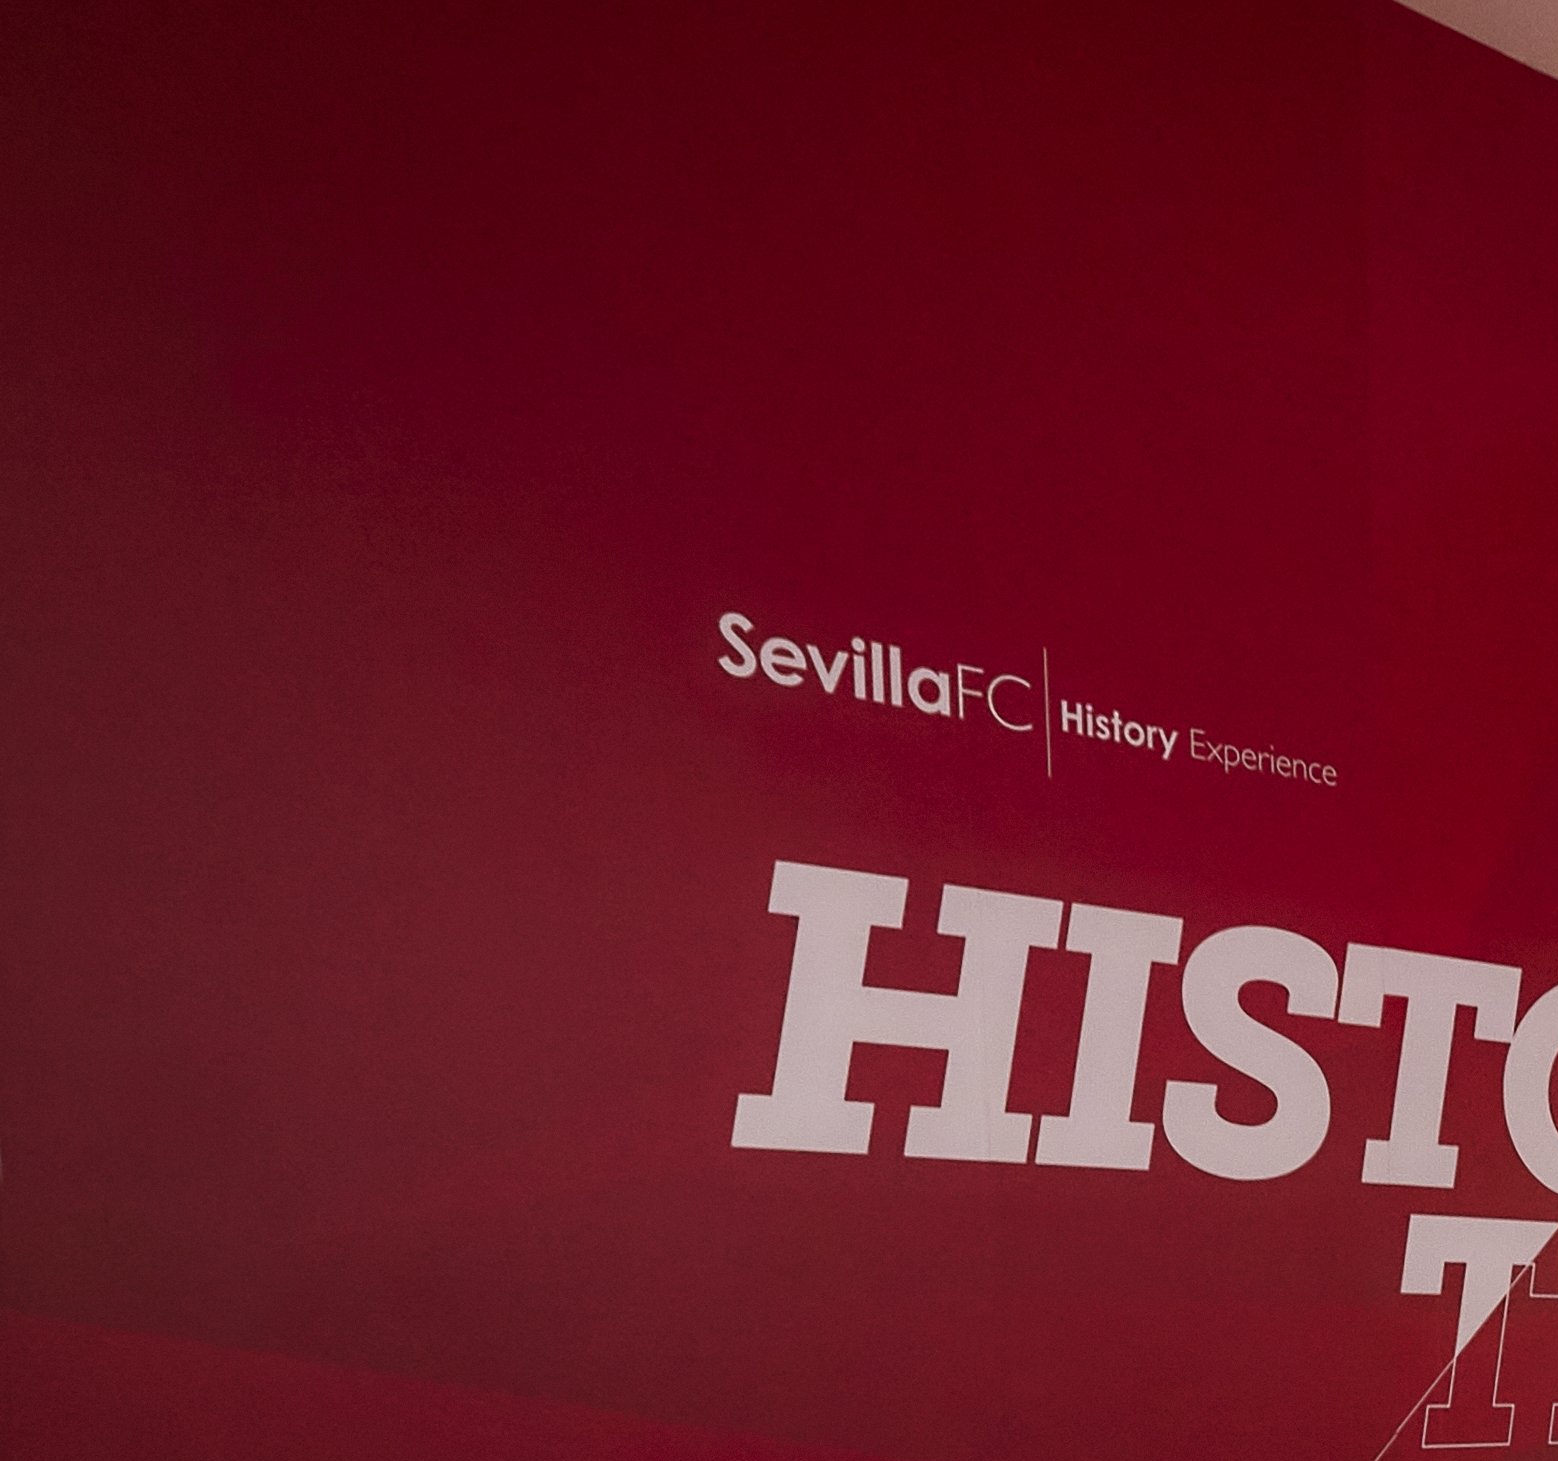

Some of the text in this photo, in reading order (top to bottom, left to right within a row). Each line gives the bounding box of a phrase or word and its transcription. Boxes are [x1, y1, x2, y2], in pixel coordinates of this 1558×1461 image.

[718, 612, 1338, 786] SevillaFC History Experience
